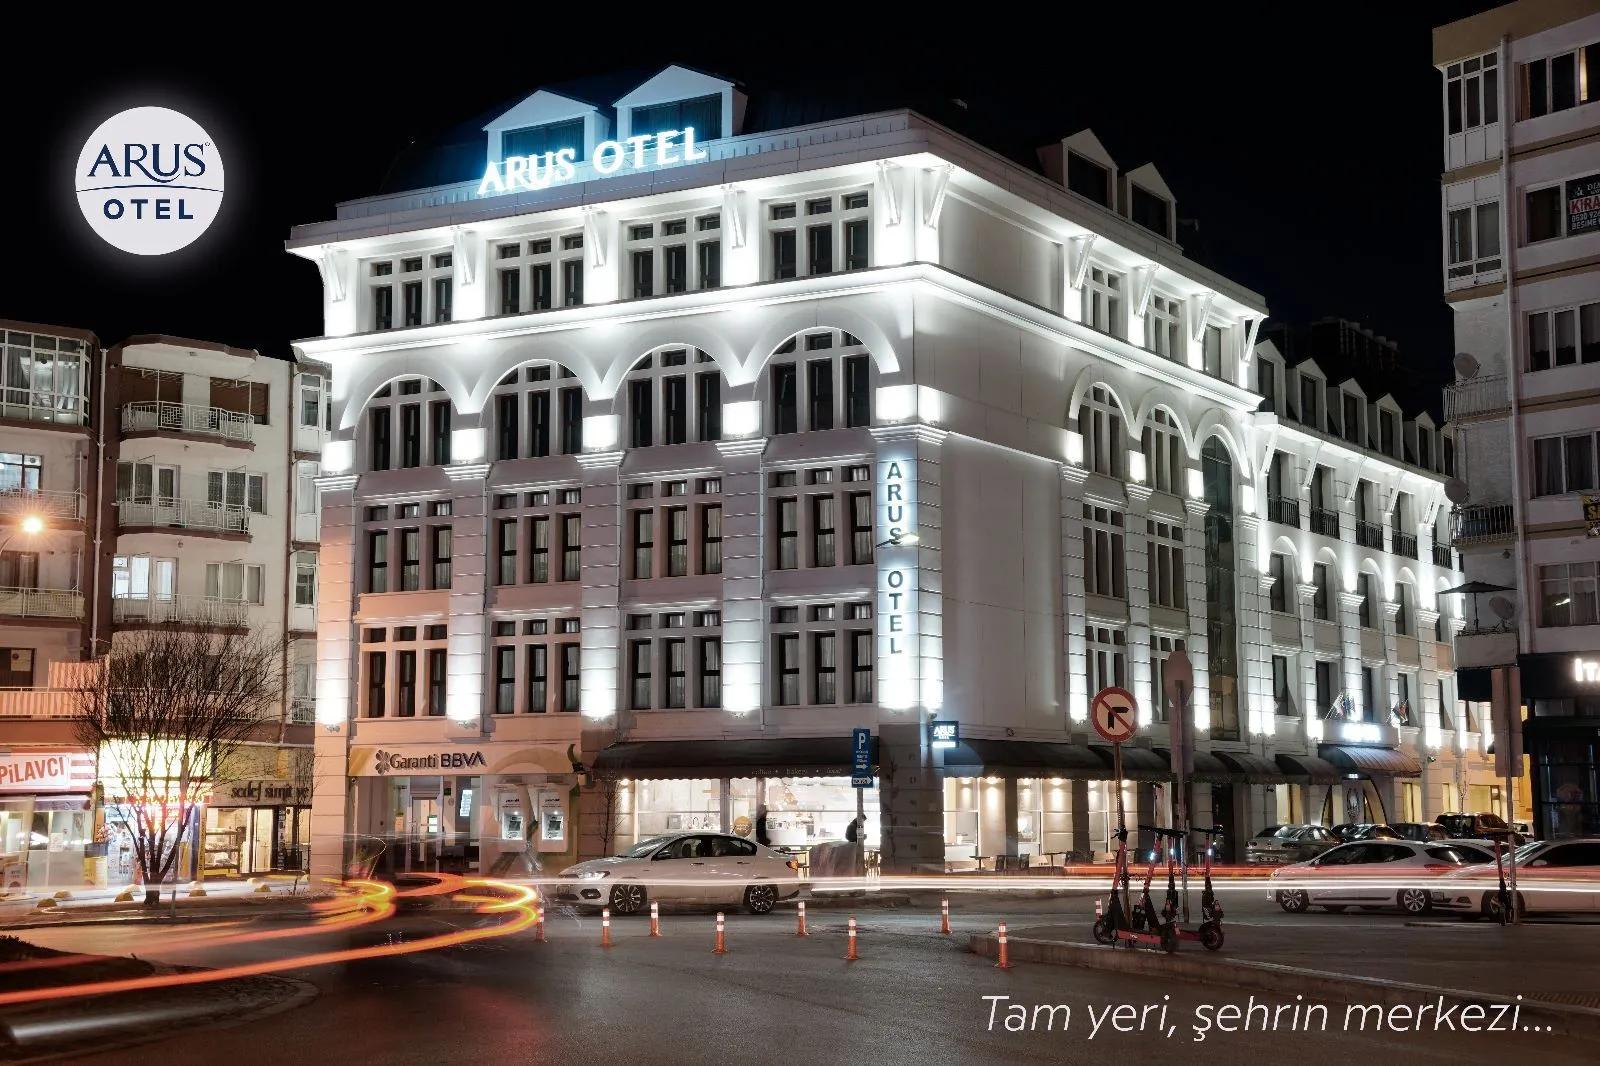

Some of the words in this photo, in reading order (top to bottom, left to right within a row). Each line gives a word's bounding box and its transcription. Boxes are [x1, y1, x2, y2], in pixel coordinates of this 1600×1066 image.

[478, 148, 575, 195] ARUS
[592, 126, 707, 174] OTEL
[887, 462, 903, 546] ARUS
[887, 570, 904, 655] OTEL
[389, 753, 437, 769] Garanti
[440, 751, 486, 768] BBVA
[858, 733, 866, 750] P
